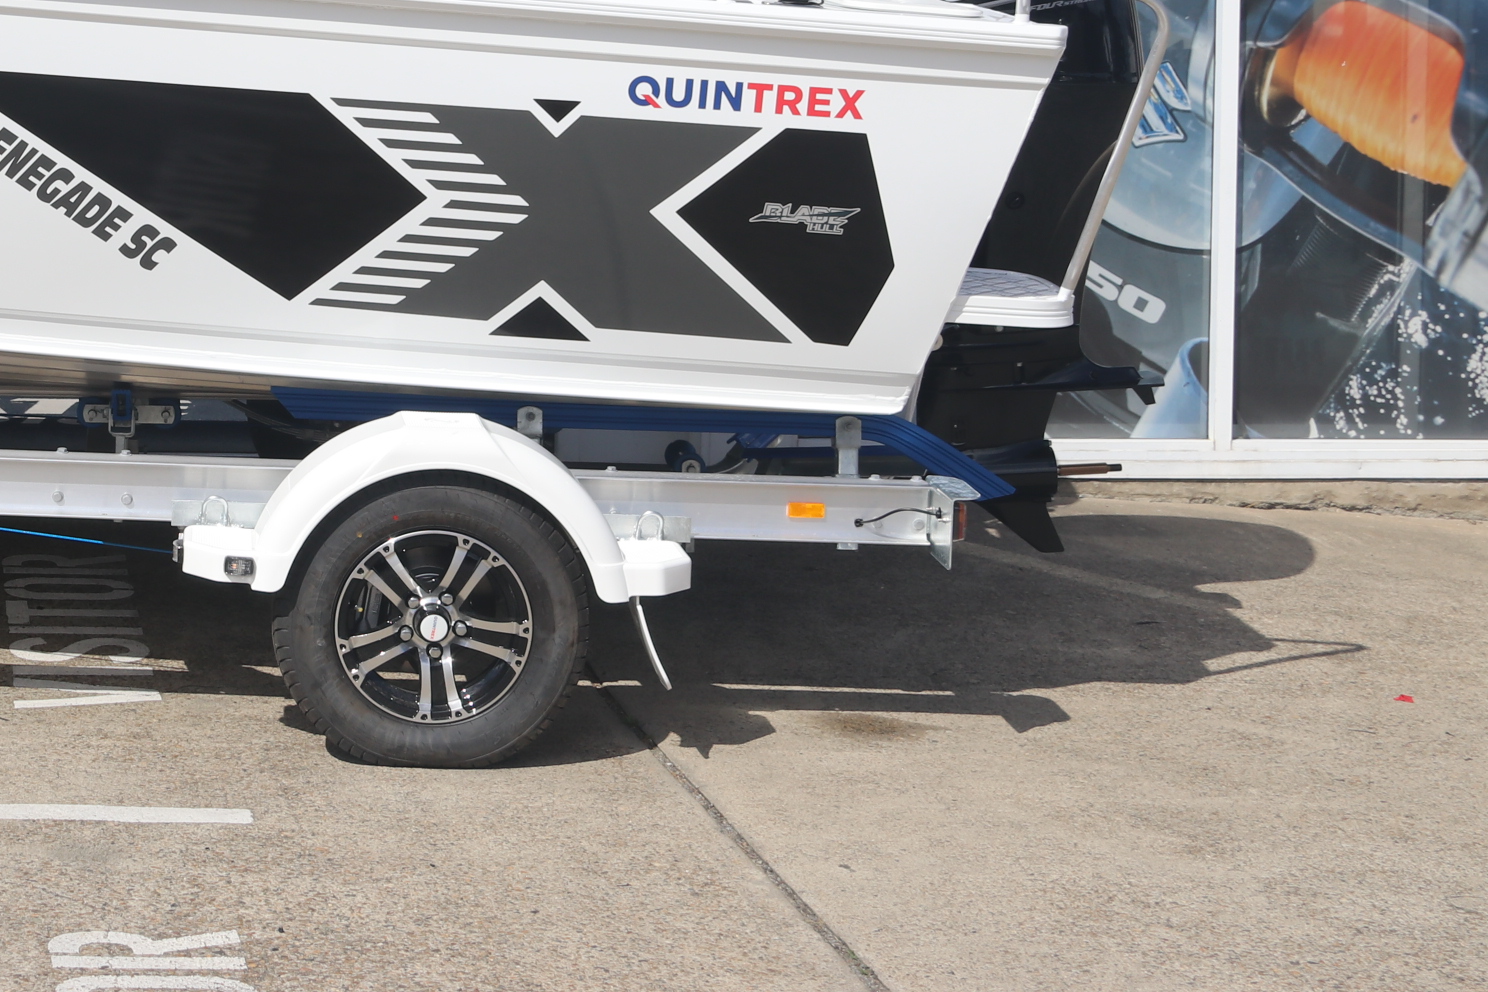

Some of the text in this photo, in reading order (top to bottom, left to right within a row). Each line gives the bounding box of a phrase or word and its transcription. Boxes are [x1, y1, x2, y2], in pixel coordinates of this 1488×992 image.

[627, 75, 866, 121] QUINTREX
[749, 202, 862, 225] BLADE
[807, 222, 844, 235] HULL
[118, 223, 178, 271] SC
[1, 554, 162, 708] VISITOR
